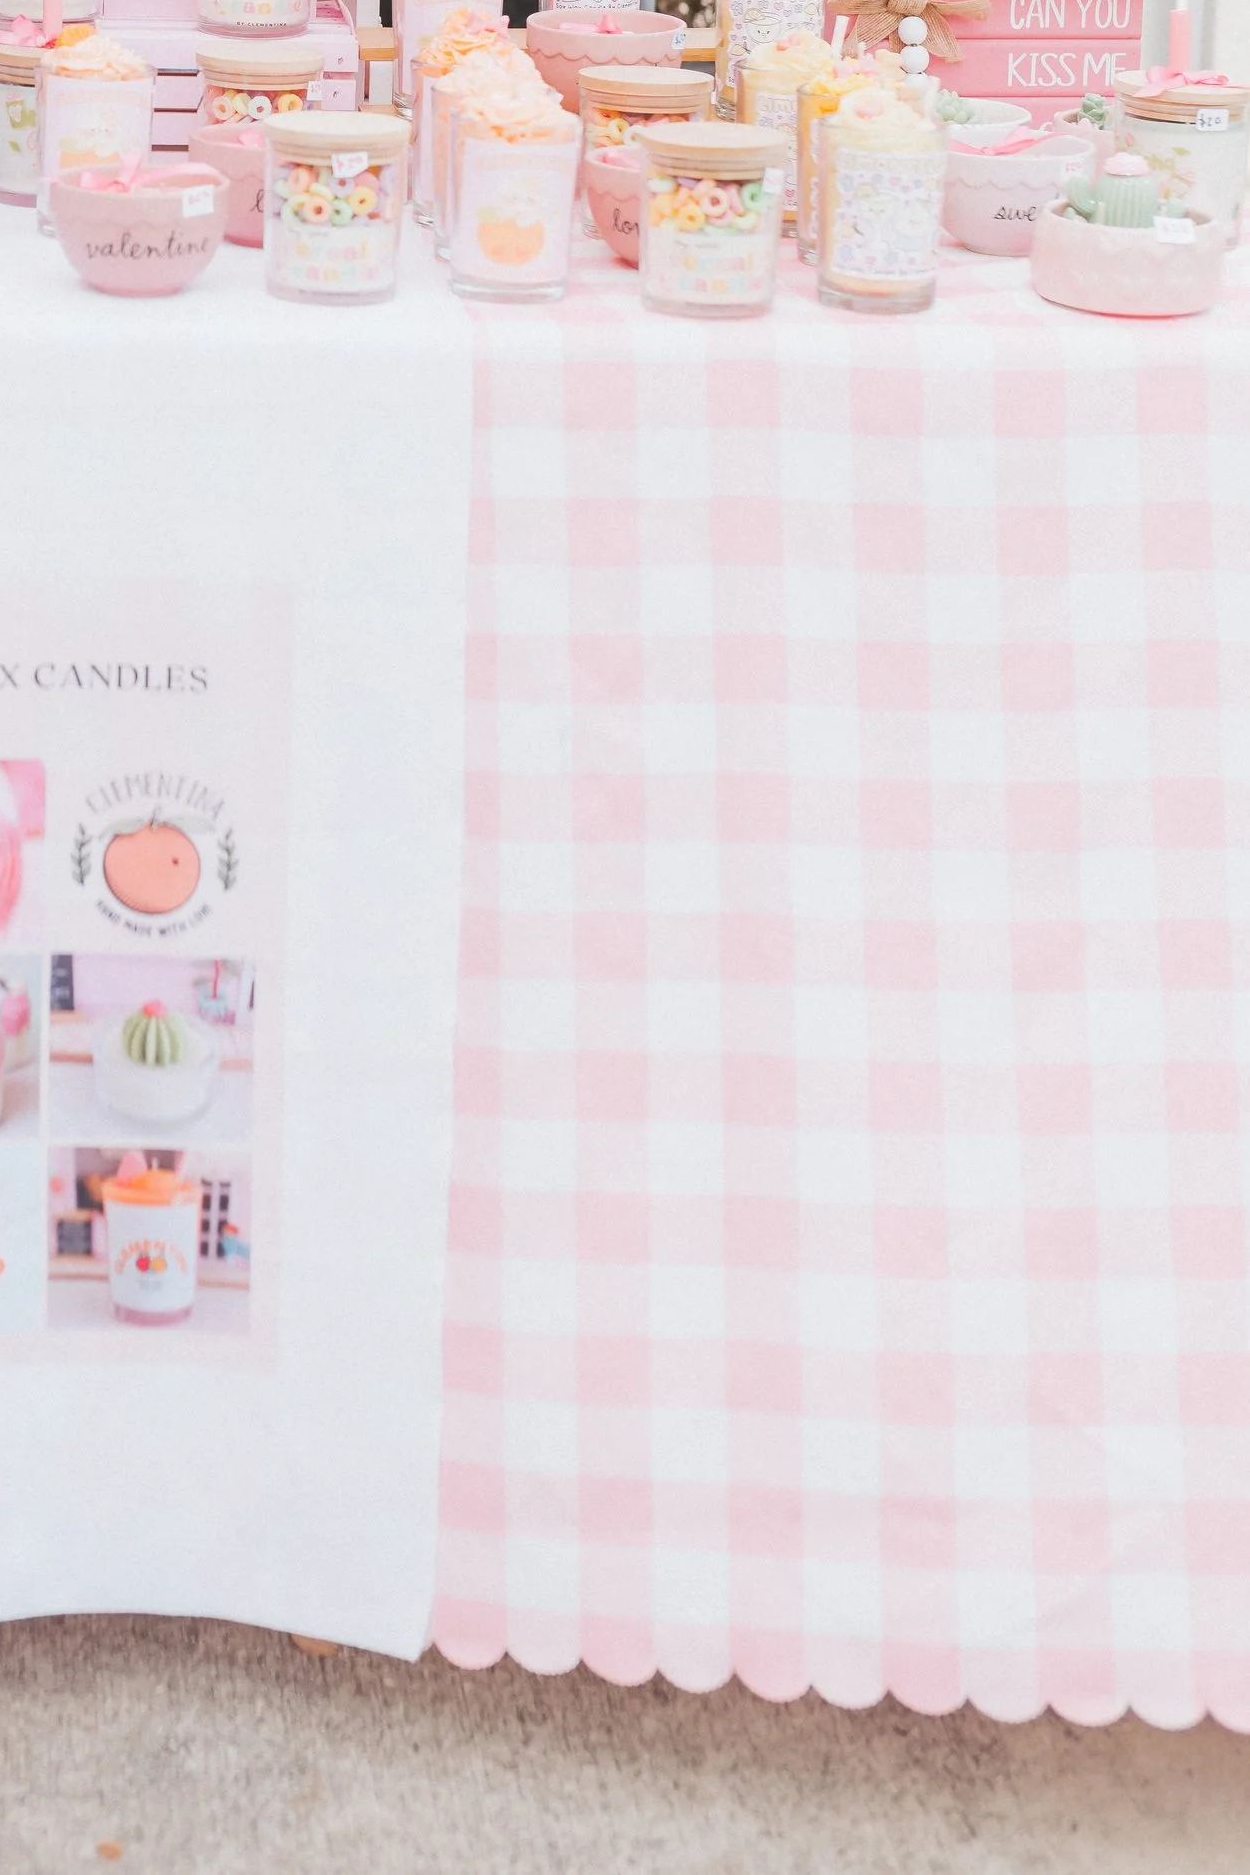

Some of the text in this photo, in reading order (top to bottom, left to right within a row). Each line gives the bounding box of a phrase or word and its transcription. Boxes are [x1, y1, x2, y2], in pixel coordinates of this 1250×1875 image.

[1007, 52, 1127, 87] KISS ME
[85, 229, 211, 260] valentine
[33, 660, 208, 694] CANDLES
[86, 771, 225, 820] CLEMENTINA
